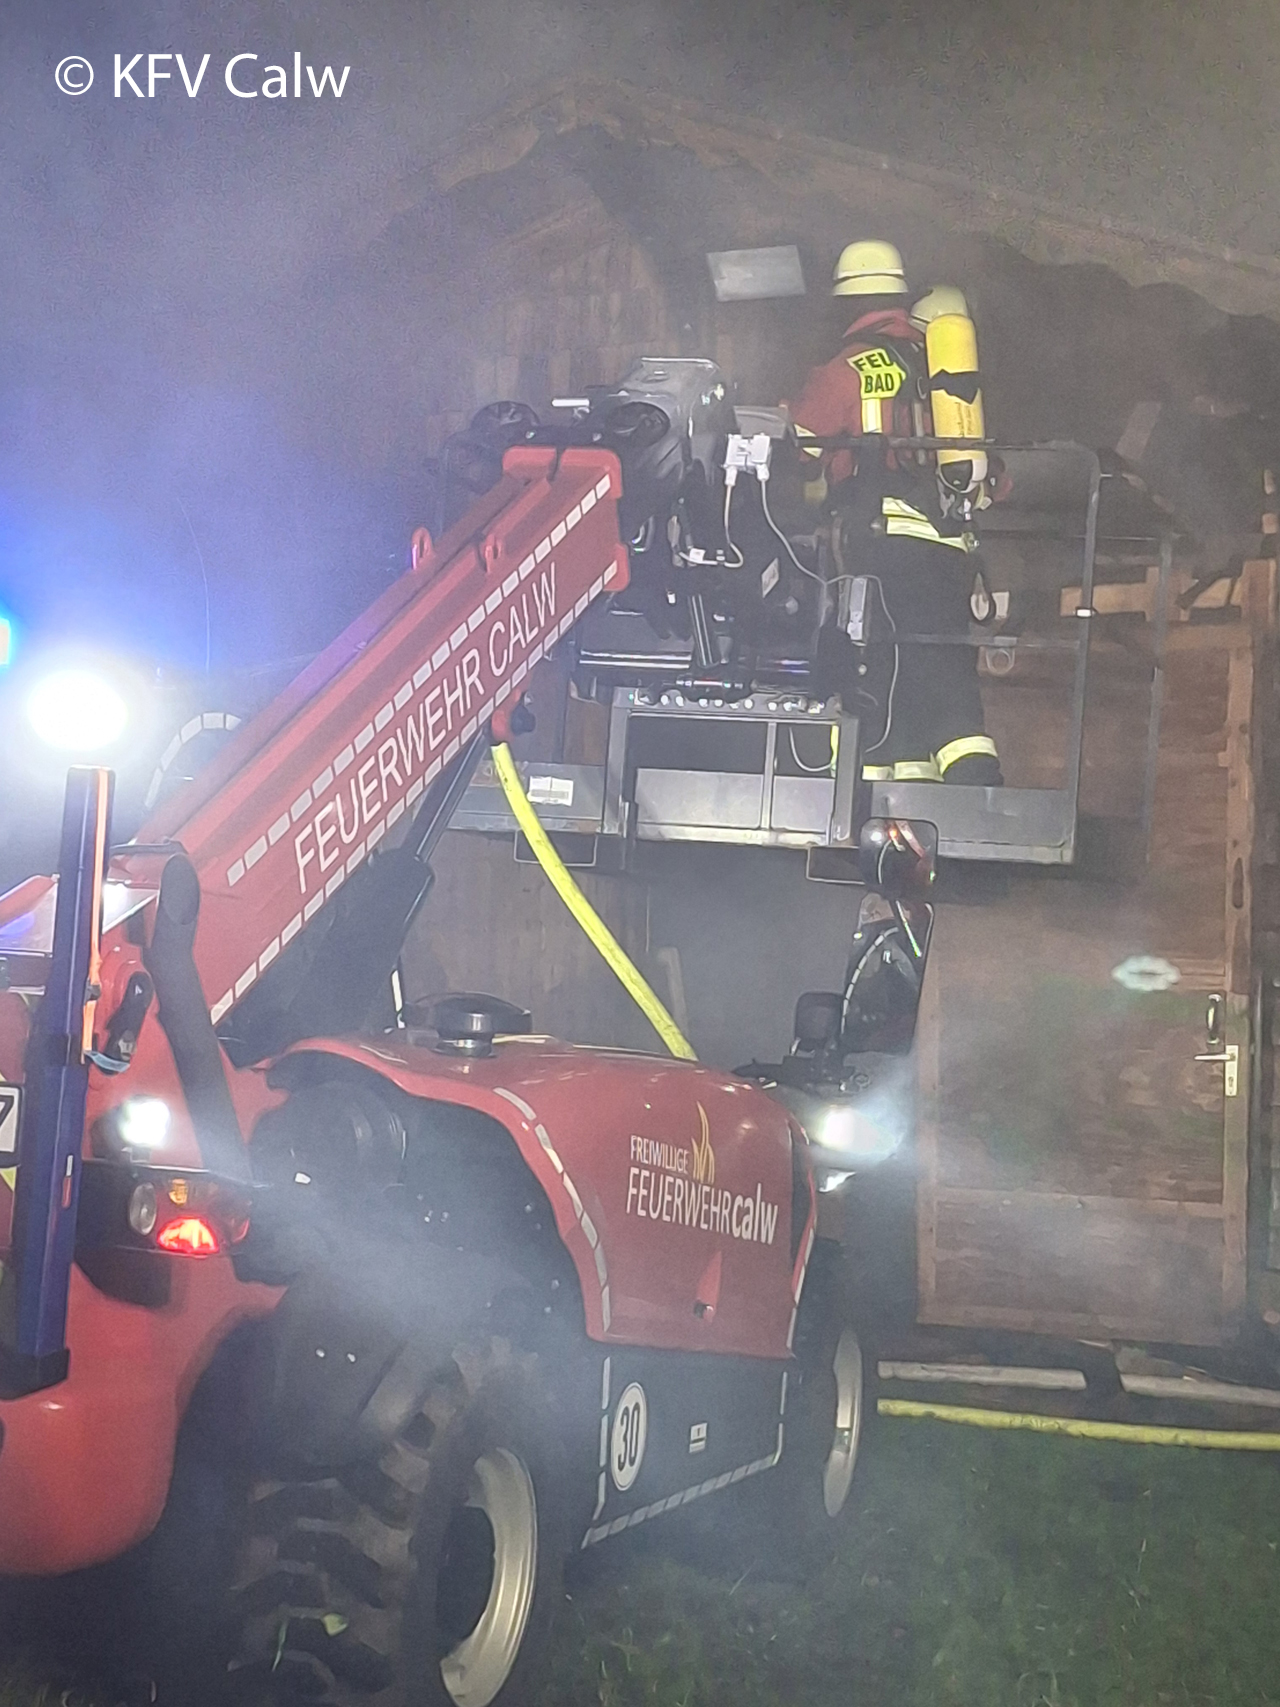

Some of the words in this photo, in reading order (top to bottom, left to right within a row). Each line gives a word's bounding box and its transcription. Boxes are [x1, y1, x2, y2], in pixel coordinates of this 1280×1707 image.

[864, 373, 895, 393] BAD
[294, 648, 485, 894] FEUERWEHR
[488, 562, 557, 677] CALW
[630, 1135, 689, 1174] FREIWILLIGE
[617, 1402, 641, 1472] 30
